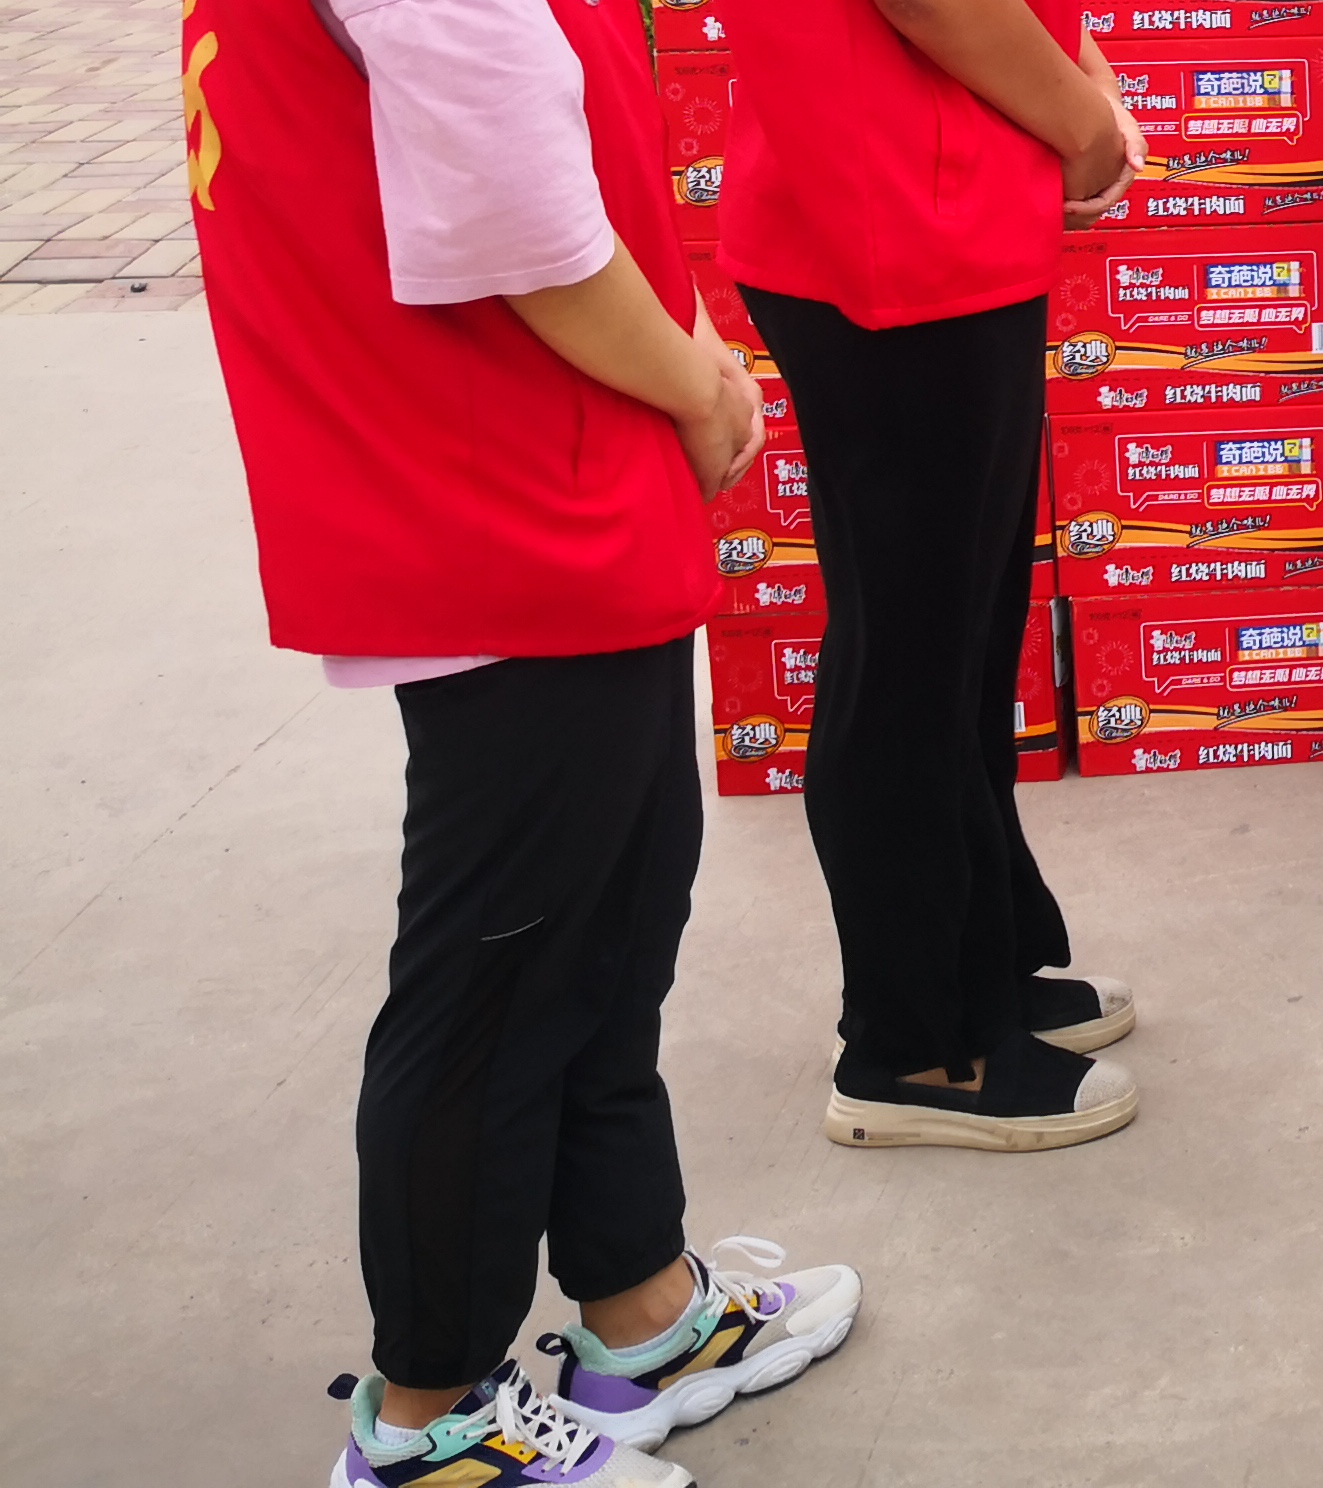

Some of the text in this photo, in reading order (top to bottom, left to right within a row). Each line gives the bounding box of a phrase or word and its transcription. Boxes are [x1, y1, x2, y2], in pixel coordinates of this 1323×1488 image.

[1132, 9, 1232, 31] 红烧牛肉面
[1198, 72, 1264, 94] 奇葩说
[1121, 94, 1177, 110] 烧牛肉面
[1147, 195, 1245, 218] 红烧牛肉面
[1209, 266, 1274, 286] 奇葩说
[1118, 286, 1189, 302] 红烧牛肉面
[1062, 339, 1108, 364] 经典
[1165, 382, 1262, 404] 红烧牛肉面
[1219, 441, 1285, 464] 奇葩说
[1127, 464, 1199, 482] 红烧牛肉面
[1068, 518, 1114, 544] 经典
[718, 538, 765, 563] 经典
[1170, 559, 1266, 582] 红烧牛肉面
[1240, 625, 1303, 648] 奇葩说
[1152, 647, 1222, 665] 红烧牛肉面
[1097, 705, 1143, 728] 经典
[731, 723, 778, 748] 经典
[1198, 740, 1292, 764] 红烧牛肉面
